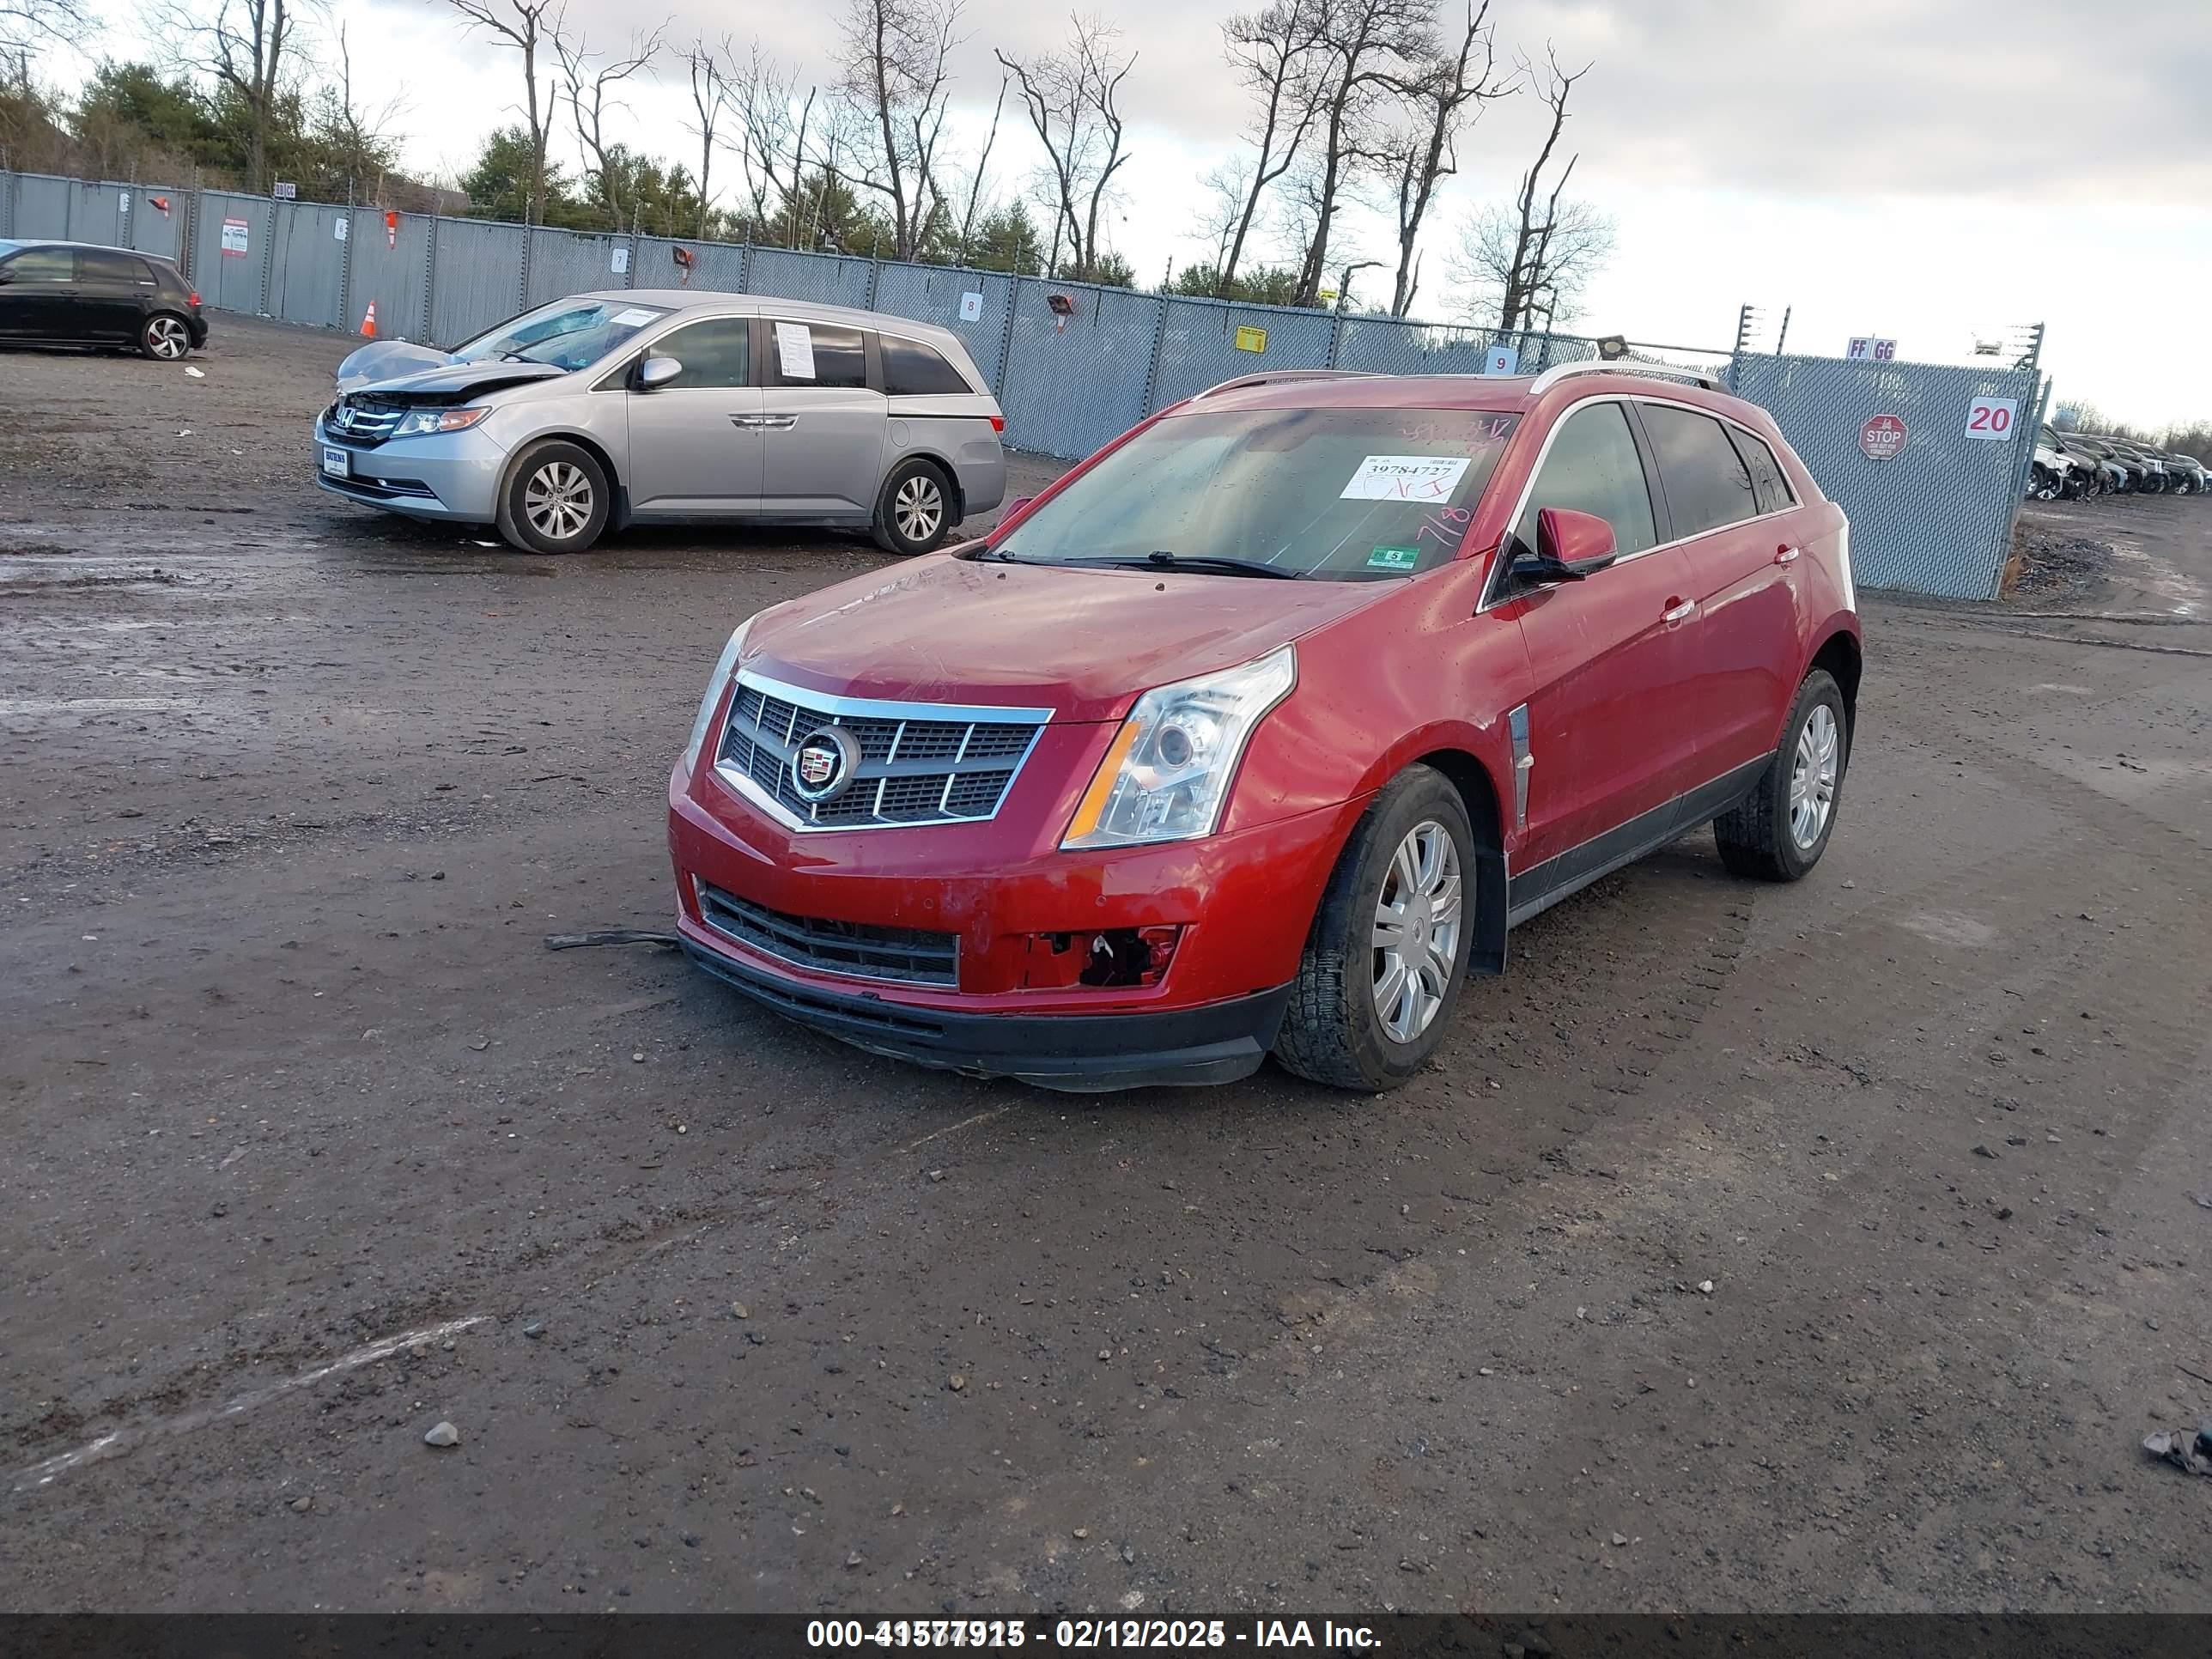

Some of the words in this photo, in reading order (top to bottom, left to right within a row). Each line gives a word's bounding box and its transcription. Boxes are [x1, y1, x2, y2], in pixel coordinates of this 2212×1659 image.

[968, 301, 974, 310] 8
[1850, 339, 1868, 358] FF
[1875, 341, 1894, 361] GG
[1497, 357, 1506, 370] 9
[1970, 406, 2010, 432] 20
[1866, 430, 1901, 443] STOP
[1367, 465, 1452, 477] 39784727
[1391, 551, 1400, 560] 5
